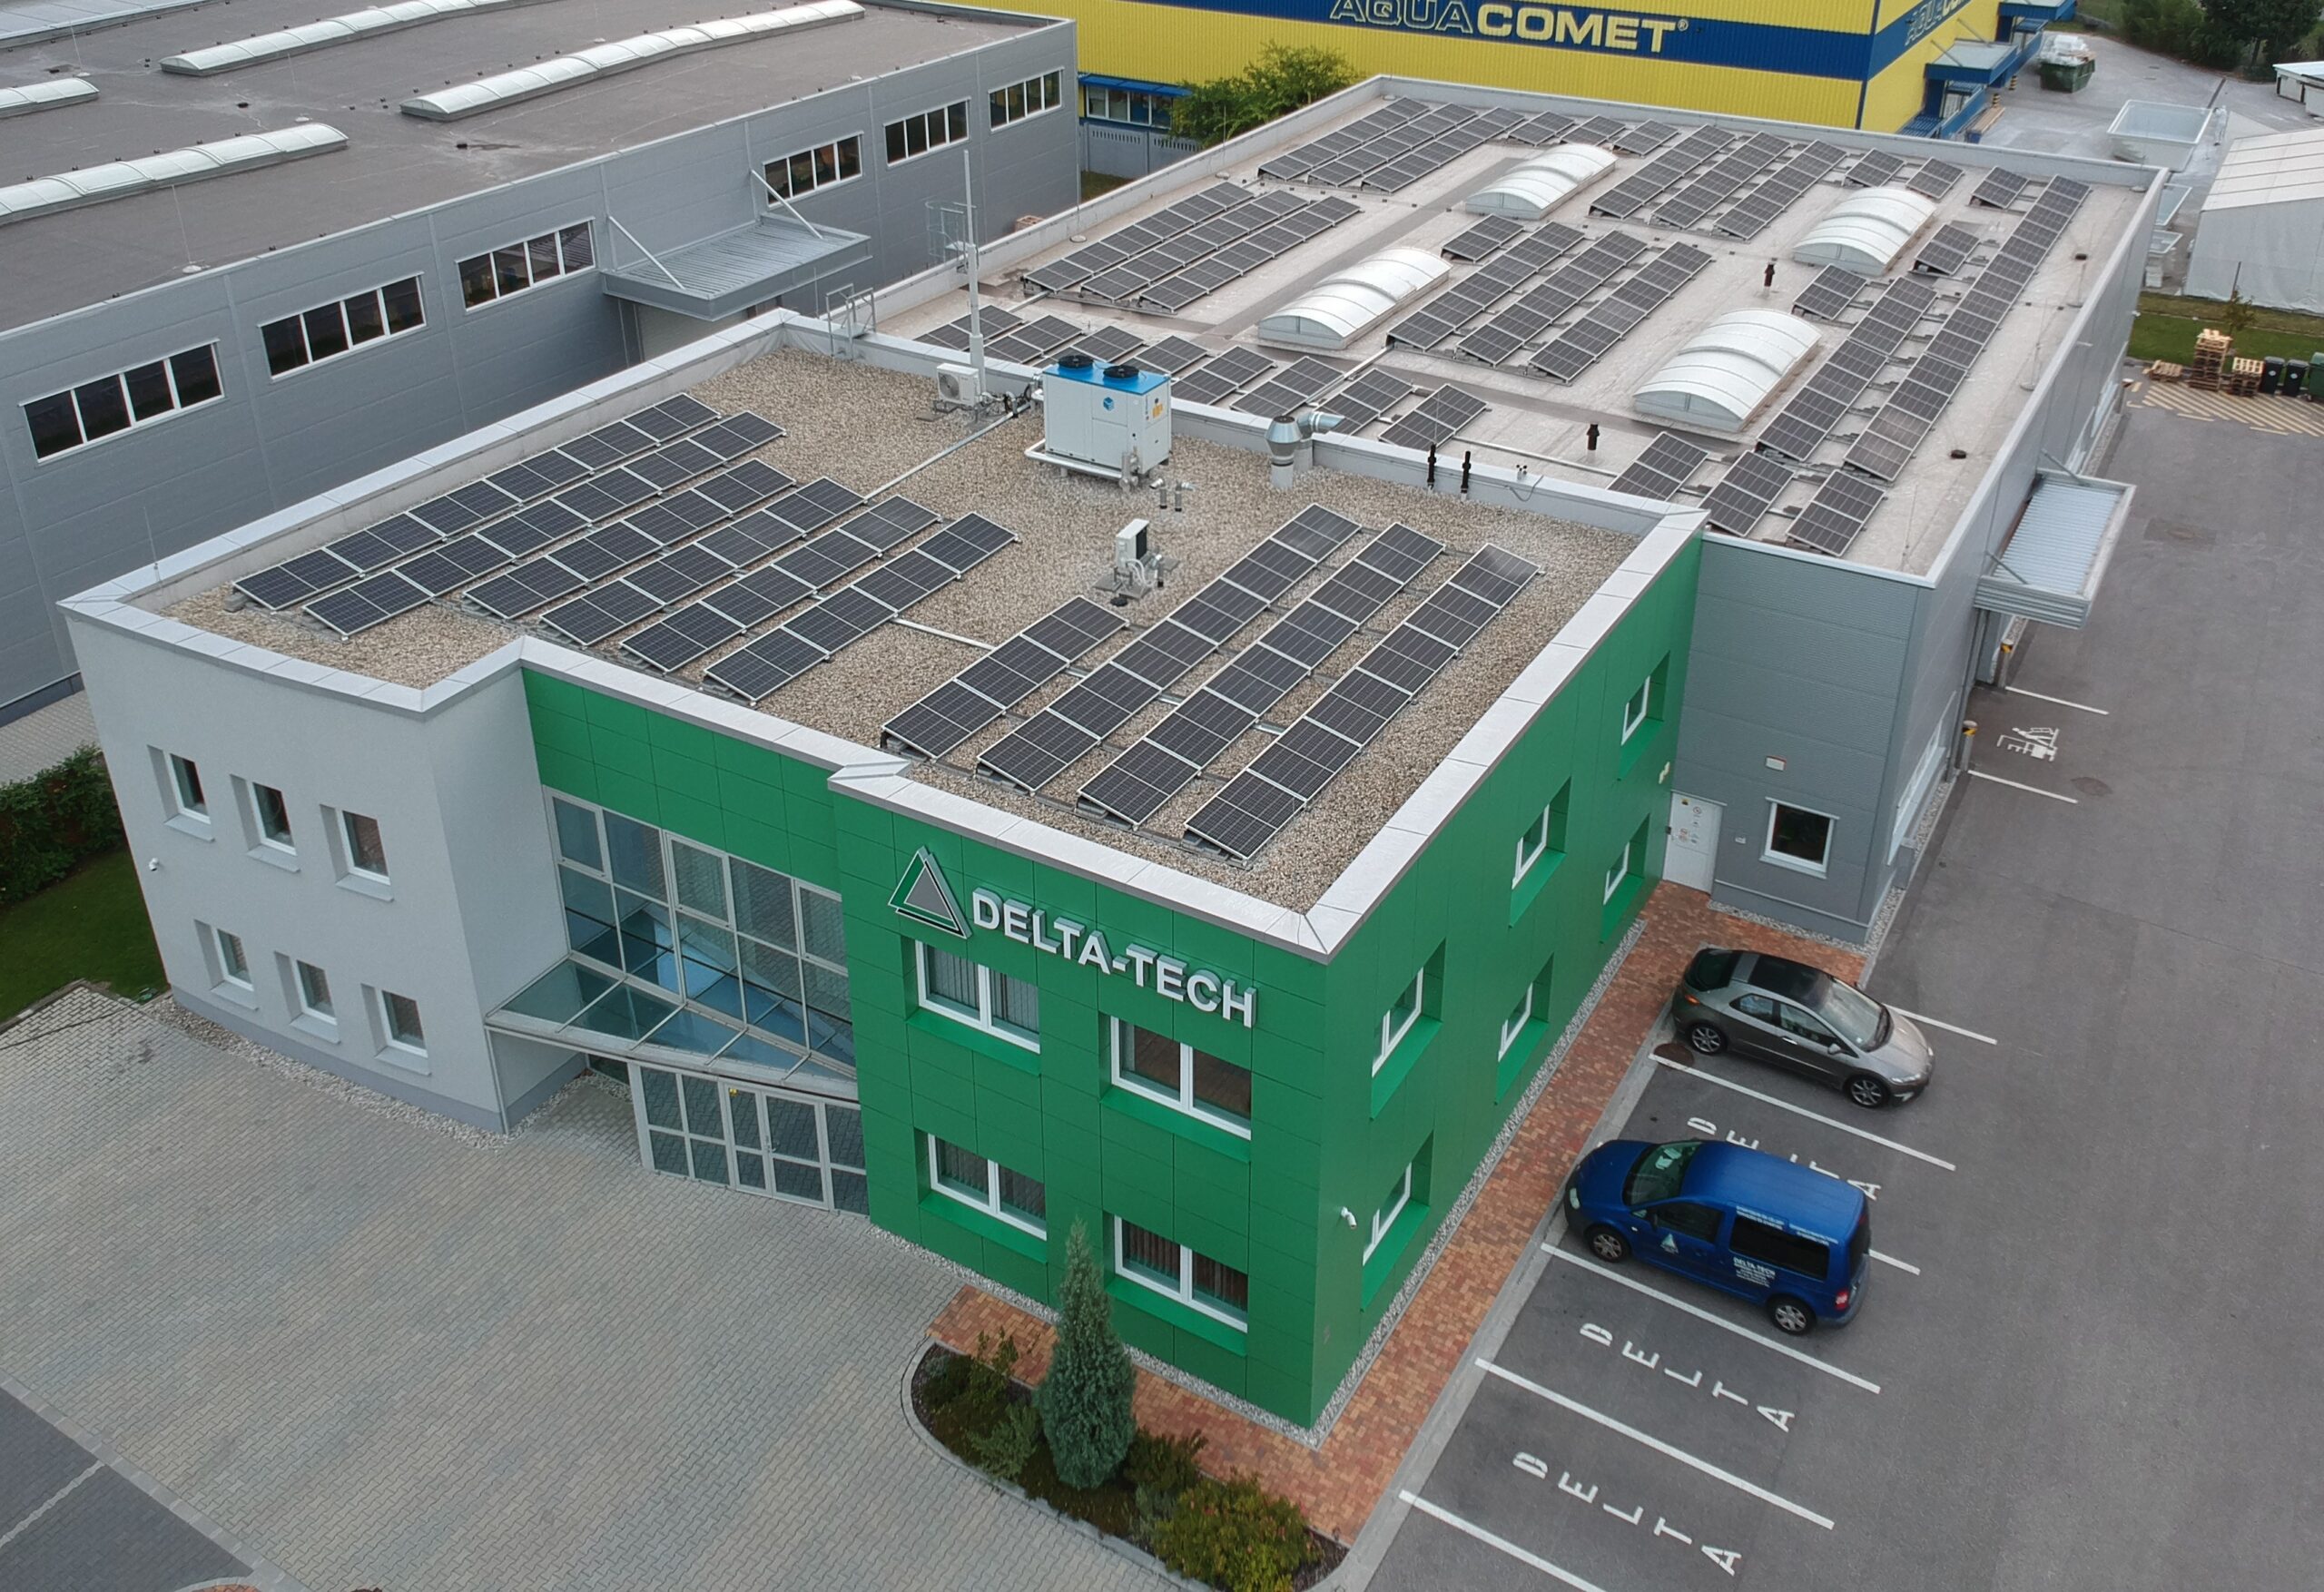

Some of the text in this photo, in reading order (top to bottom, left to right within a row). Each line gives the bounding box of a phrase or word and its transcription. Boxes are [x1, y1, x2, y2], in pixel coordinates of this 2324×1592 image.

[972, 887, 1257, 1027] DELTA-TECH
[1580, 1322, 1795, 1432] DELTA
[1512, 1451, 1742, 1576] DELTA
